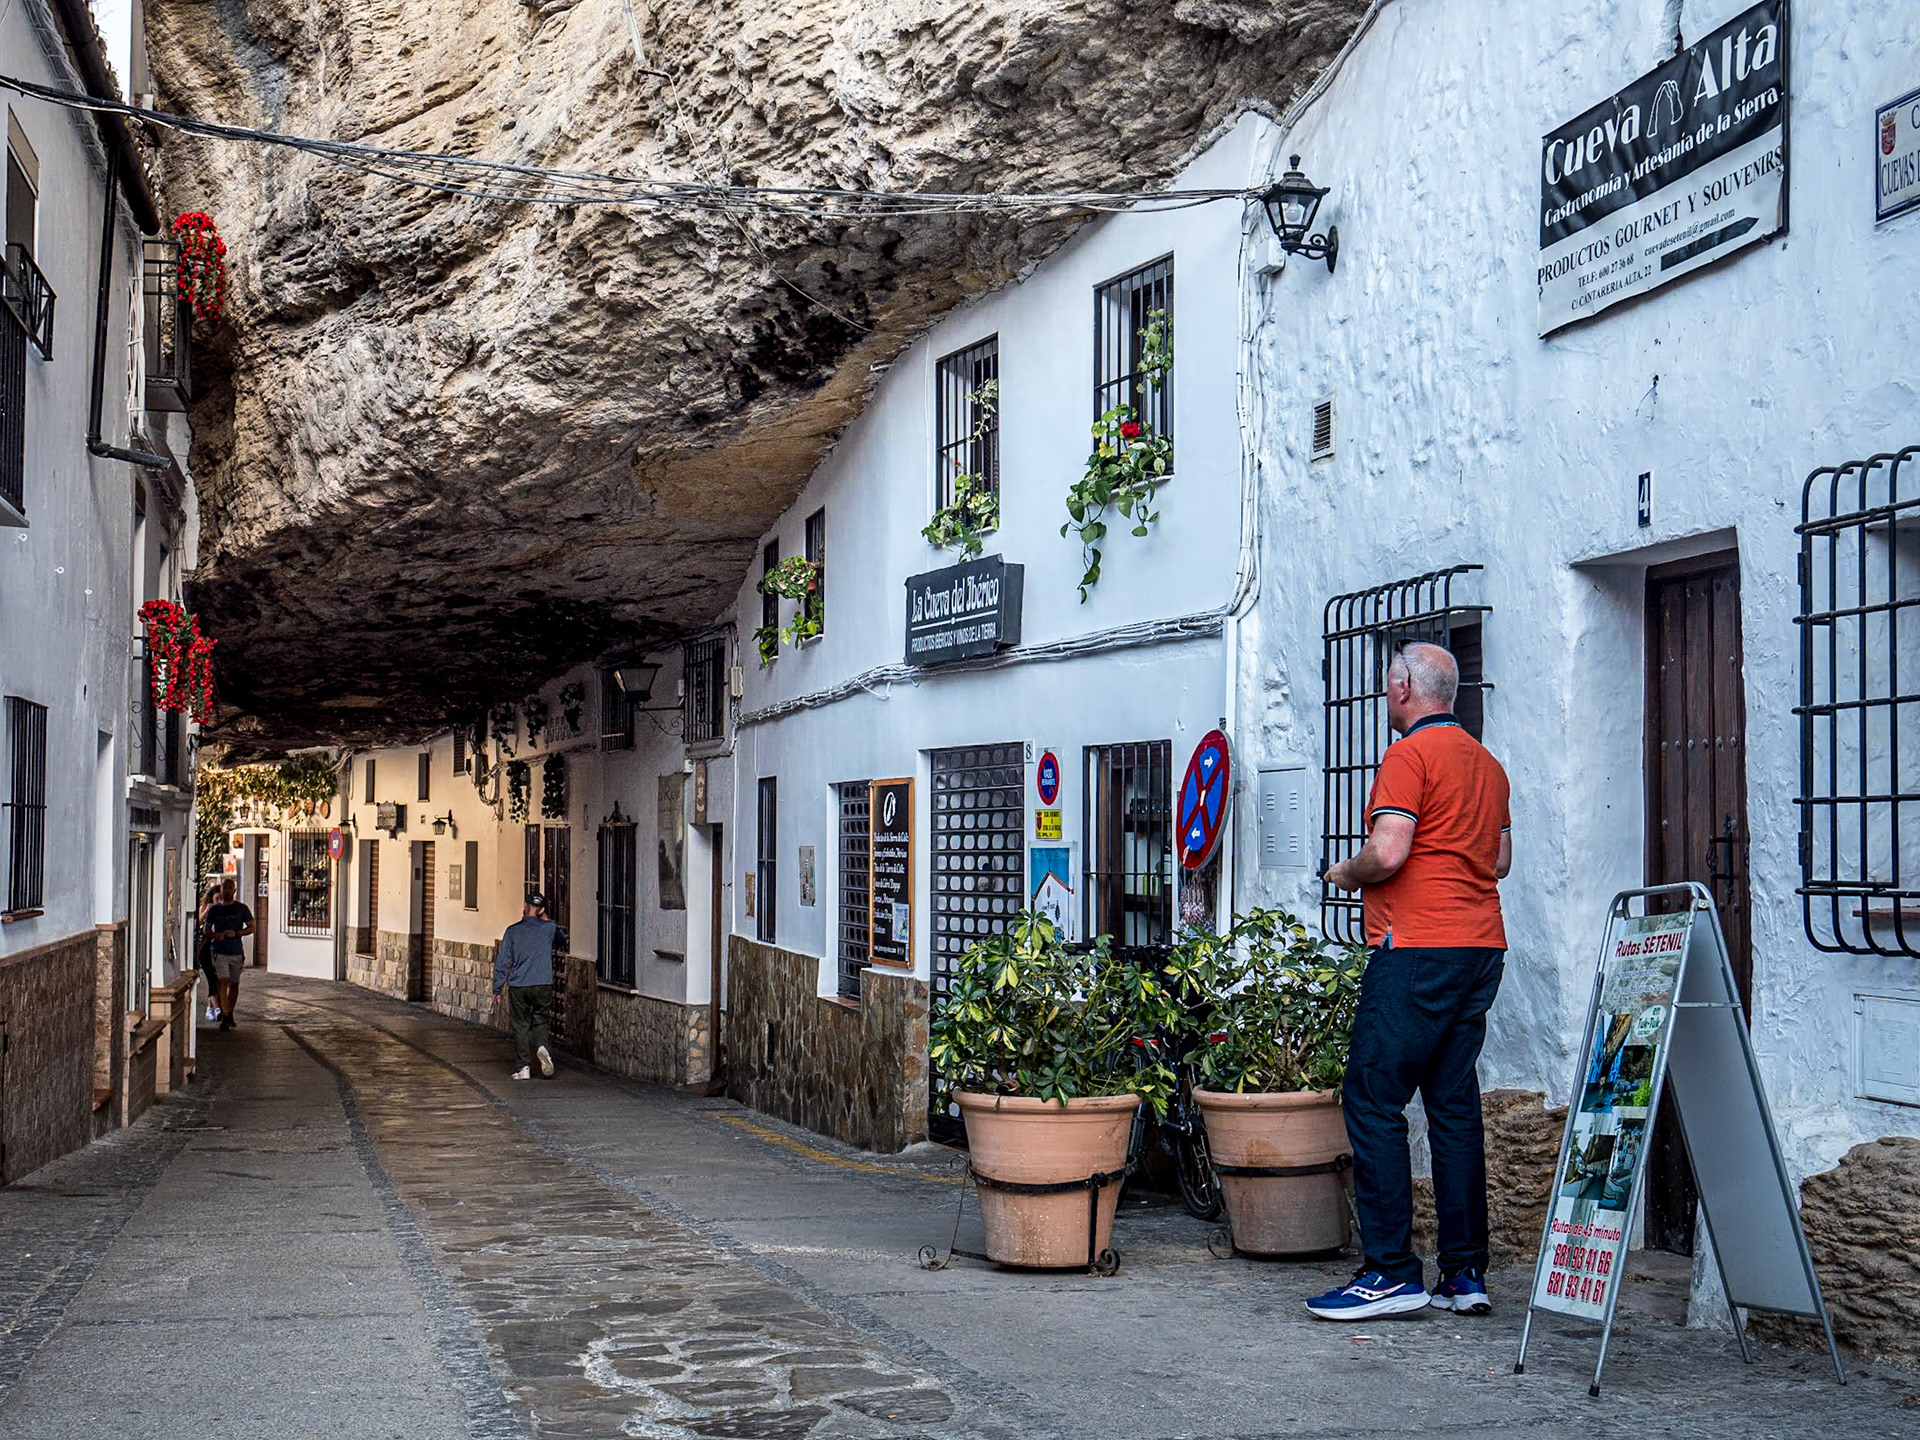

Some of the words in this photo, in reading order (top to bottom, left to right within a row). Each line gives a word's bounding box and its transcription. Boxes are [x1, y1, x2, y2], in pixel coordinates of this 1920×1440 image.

[1545, 104, 1640, 185] Cueva
[1693, 24, 1777, 107] Alta
[1624, 170, 1631, 190] y
[1632, 132, 1694, 182] Artesanía
[1696, 123, 1713, 145] de
[1716, 114, 1731, 134] la
[1733, 86, 1779, 125] Sierra
[1881, 151, 1915, 197] CUEVAS
[1537, 235, 1610, 285] PRODUCTOS
[1687, 191, 1697, 213] Y
[1702, 145, 1783, 206] SOUVENIRS
[1644, 264, 1652, 278] 22
[1639, 477, 1650, 518] 4
[911, 589, 923, 623] La
[924, 586, 950, 621] Cueva
[951, 577, 965, 614] del
[966, 573, 999, 611] Ibérico
[1025, 743, 1032, 760] 8
[1615, 940, 1641, 957] Rutas
[1642, 932, 1684, 955] SETENIL
[1552, 1217, 1573, 1234] Rutas
[1572, 1220, 1583, 1237] de
[1583, 1222, 1595, 1238] 45
[1553, 1243, 1571, 1269] 681
[1570, 1246, 1585, 1271] 93
[1585, 1248, 1598, 1274] 41
[1597, 1250, 1613, 1276] 66
[1547, 1270, 1566, 1297] 681
[1565, 1274, 1580, 1300] 93
[1579, 1277, 1593, 1303] 41
[1592, 1279, 1608, 1306] 61
